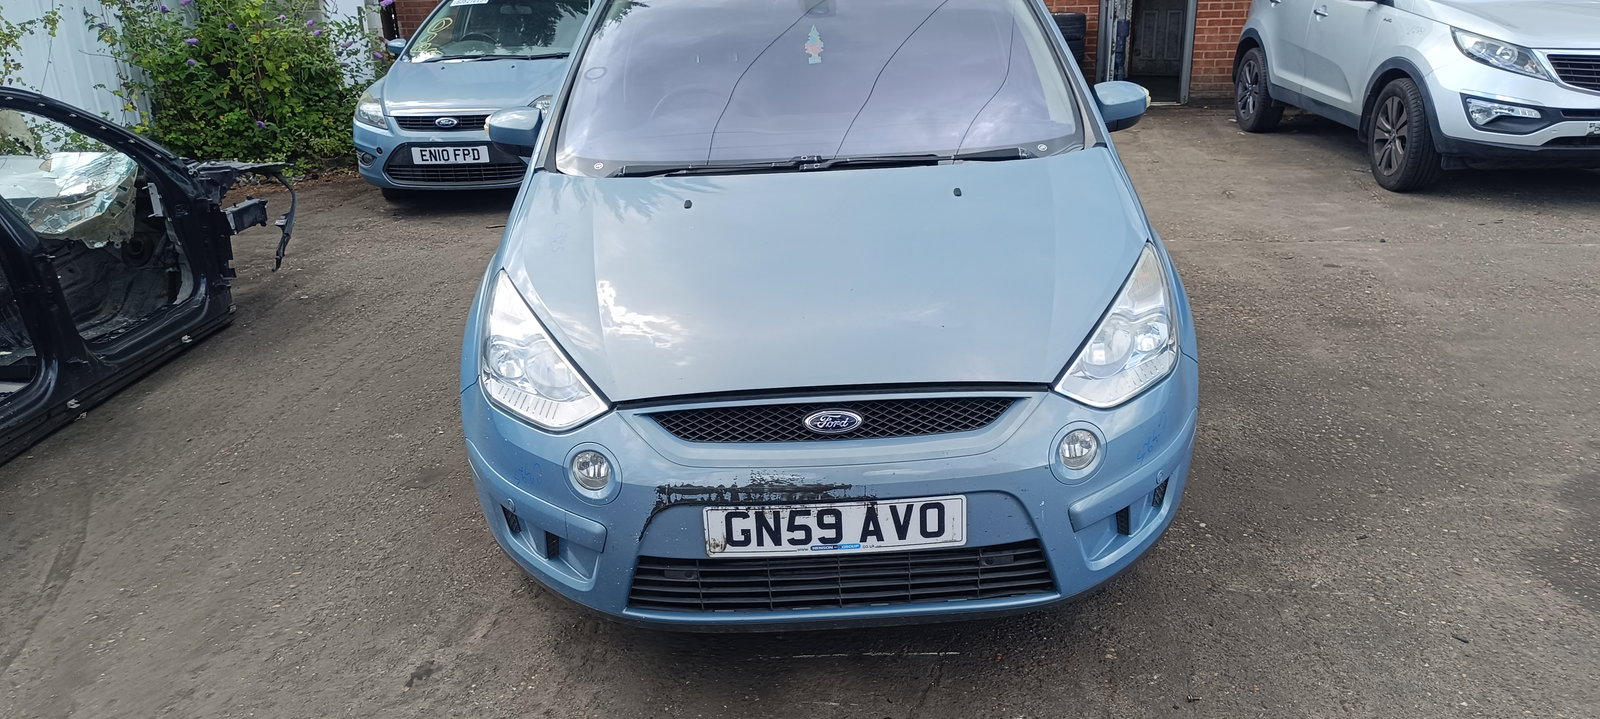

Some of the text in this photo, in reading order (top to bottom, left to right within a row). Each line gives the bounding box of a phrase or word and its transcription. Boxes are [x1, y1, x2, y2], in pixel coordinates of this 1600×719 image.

[420, 148, 480, 162] EN10 FPD
[817, 415, 849, 428] Ford
[725, 502, 945, 547] GN59 AVO
